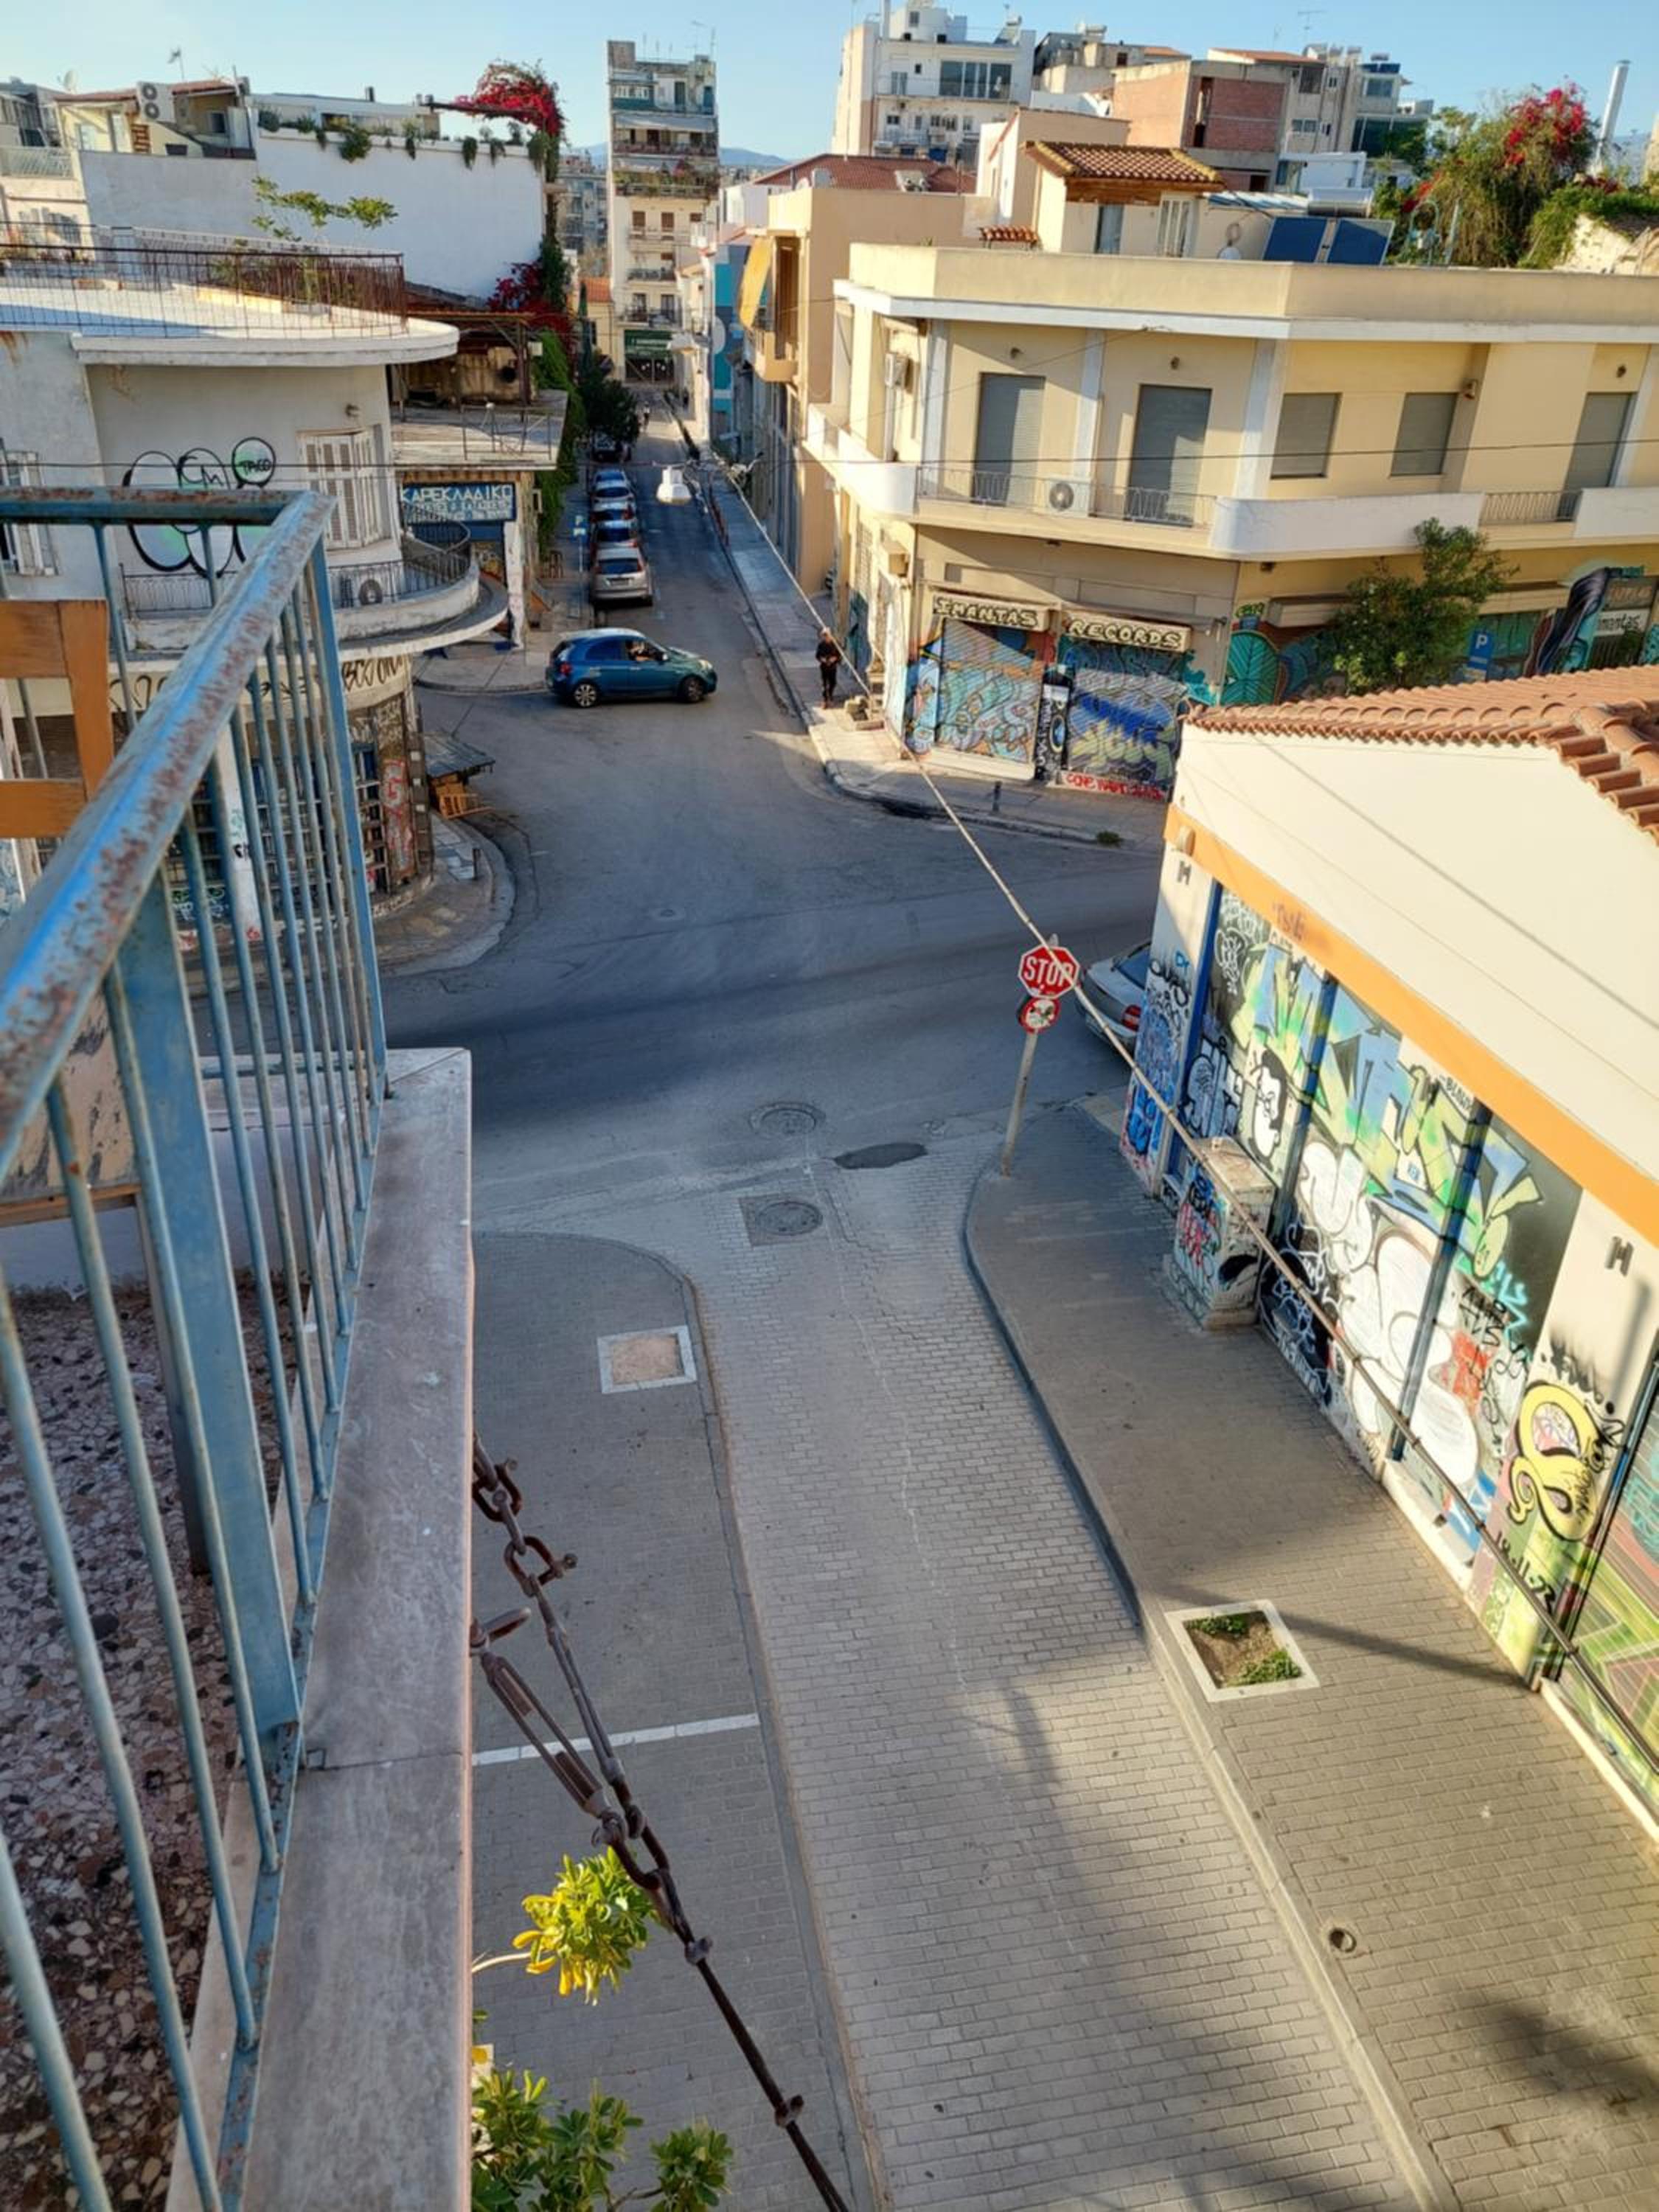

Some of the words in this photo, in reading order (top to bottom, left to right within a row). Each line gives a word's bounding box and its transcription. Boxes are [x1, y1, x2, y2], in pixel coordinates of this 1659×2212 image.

[936, 599, 1037, 627] IMANTAS
[1067, 618, 1180, 650] RECORDS
[1475, 633, 1489, 649] P
[1023, 956, 1074, 987] STOP
